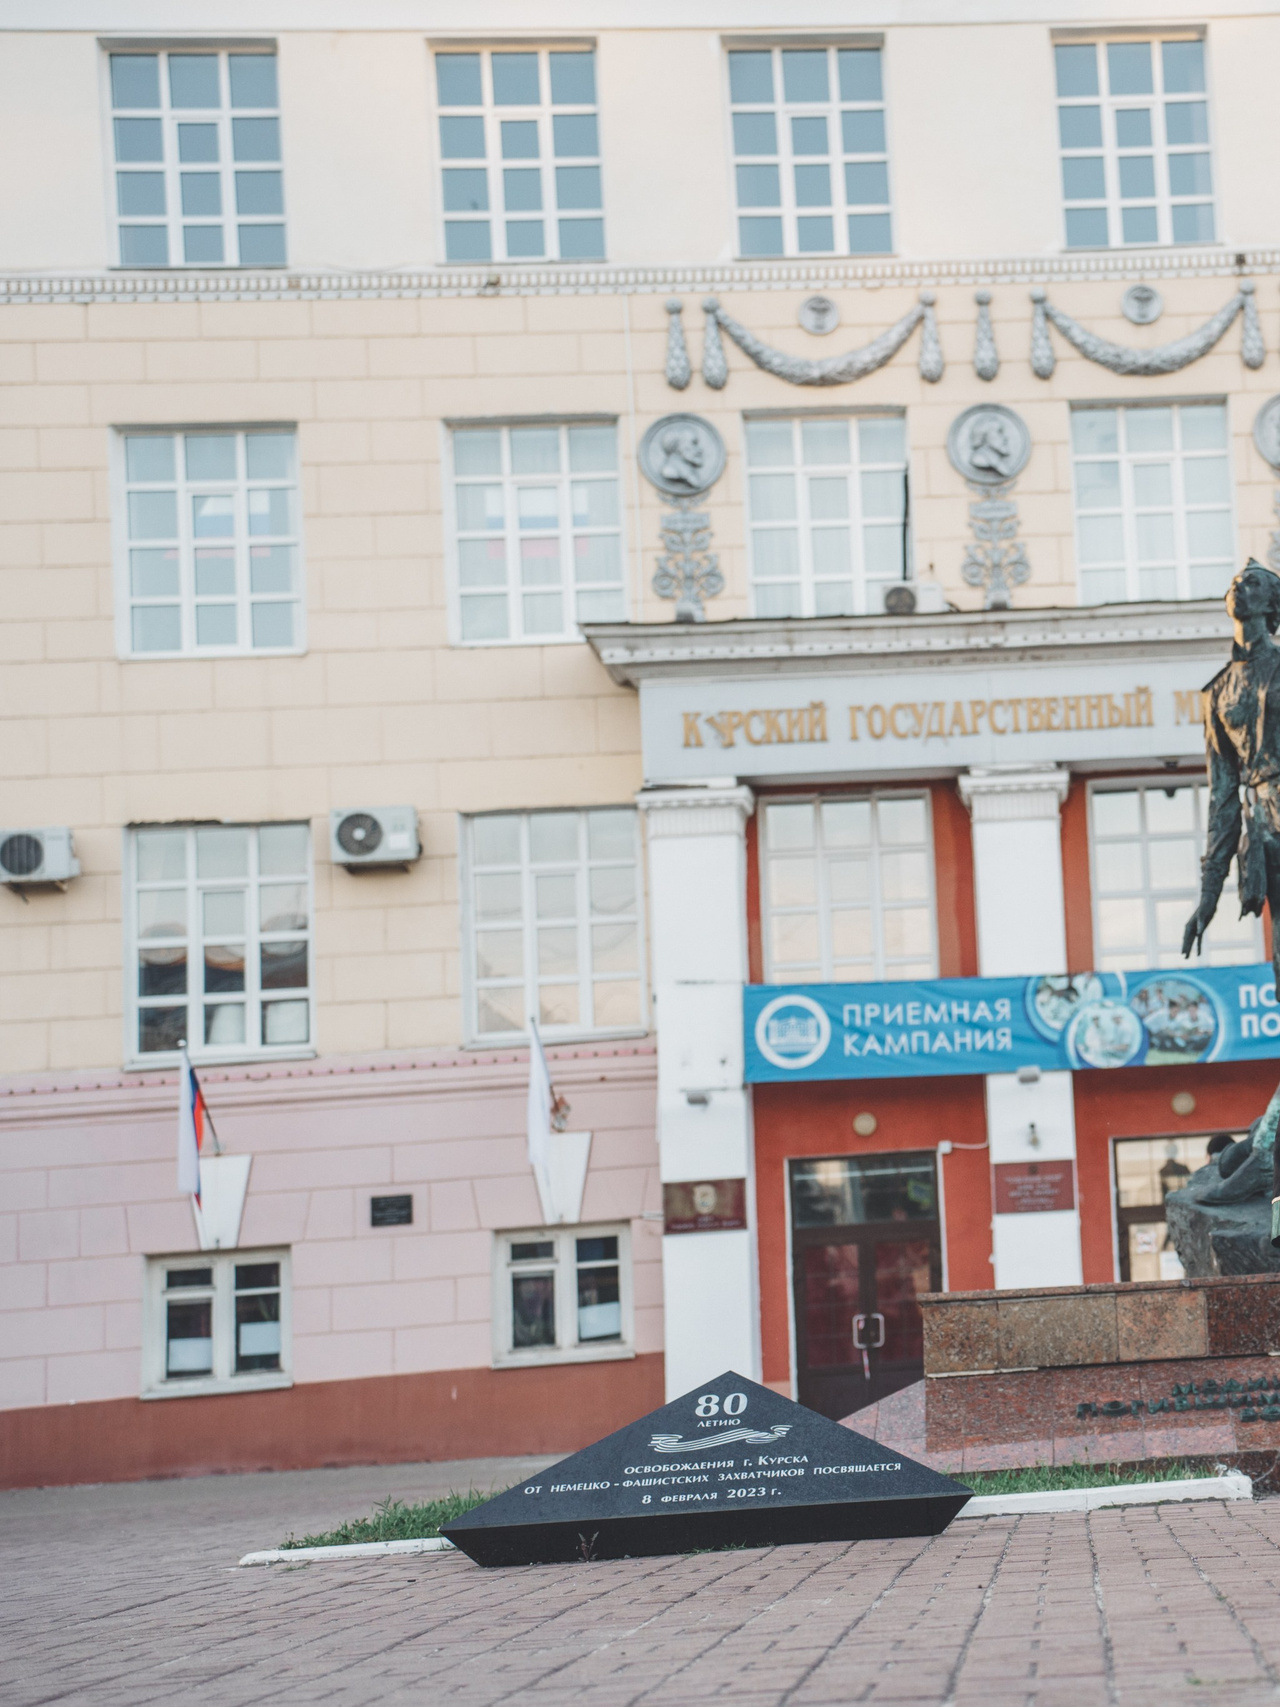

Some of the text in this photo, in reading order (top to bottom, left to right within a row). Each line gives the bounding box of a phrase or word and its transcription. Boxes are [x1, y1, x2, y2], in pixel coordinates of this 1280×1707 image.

[682, 701, 828, 748] КУРСКИЙ
[849, 686, 1154, 742] ГОСУДАРСТВЕННЫЙ
[842, 997, 1012, 1028] ПРИЕМНАЯ
[843, 1027, 1013, 1057] КАМПАНИЯ
[694, 1392, 748, 1418] 80
[696, 1418, 741, 1428] ЛЕТИЮ
[624, 1460, 735, 1475] ОСВОБОЖДЕНИЯ
[758, 1455, 809, 1467] КУРСКА
[524, 1486, 543, 1495] ОТ
[717, 1468, 805, 1482] ЗАХВАТЧИКОВ
[641, 1494, 652, 1505] 8
[660, 1492, 718, 1503] ФЕВРАЛЯ
[727, 1487, 767, 1499] 2023
